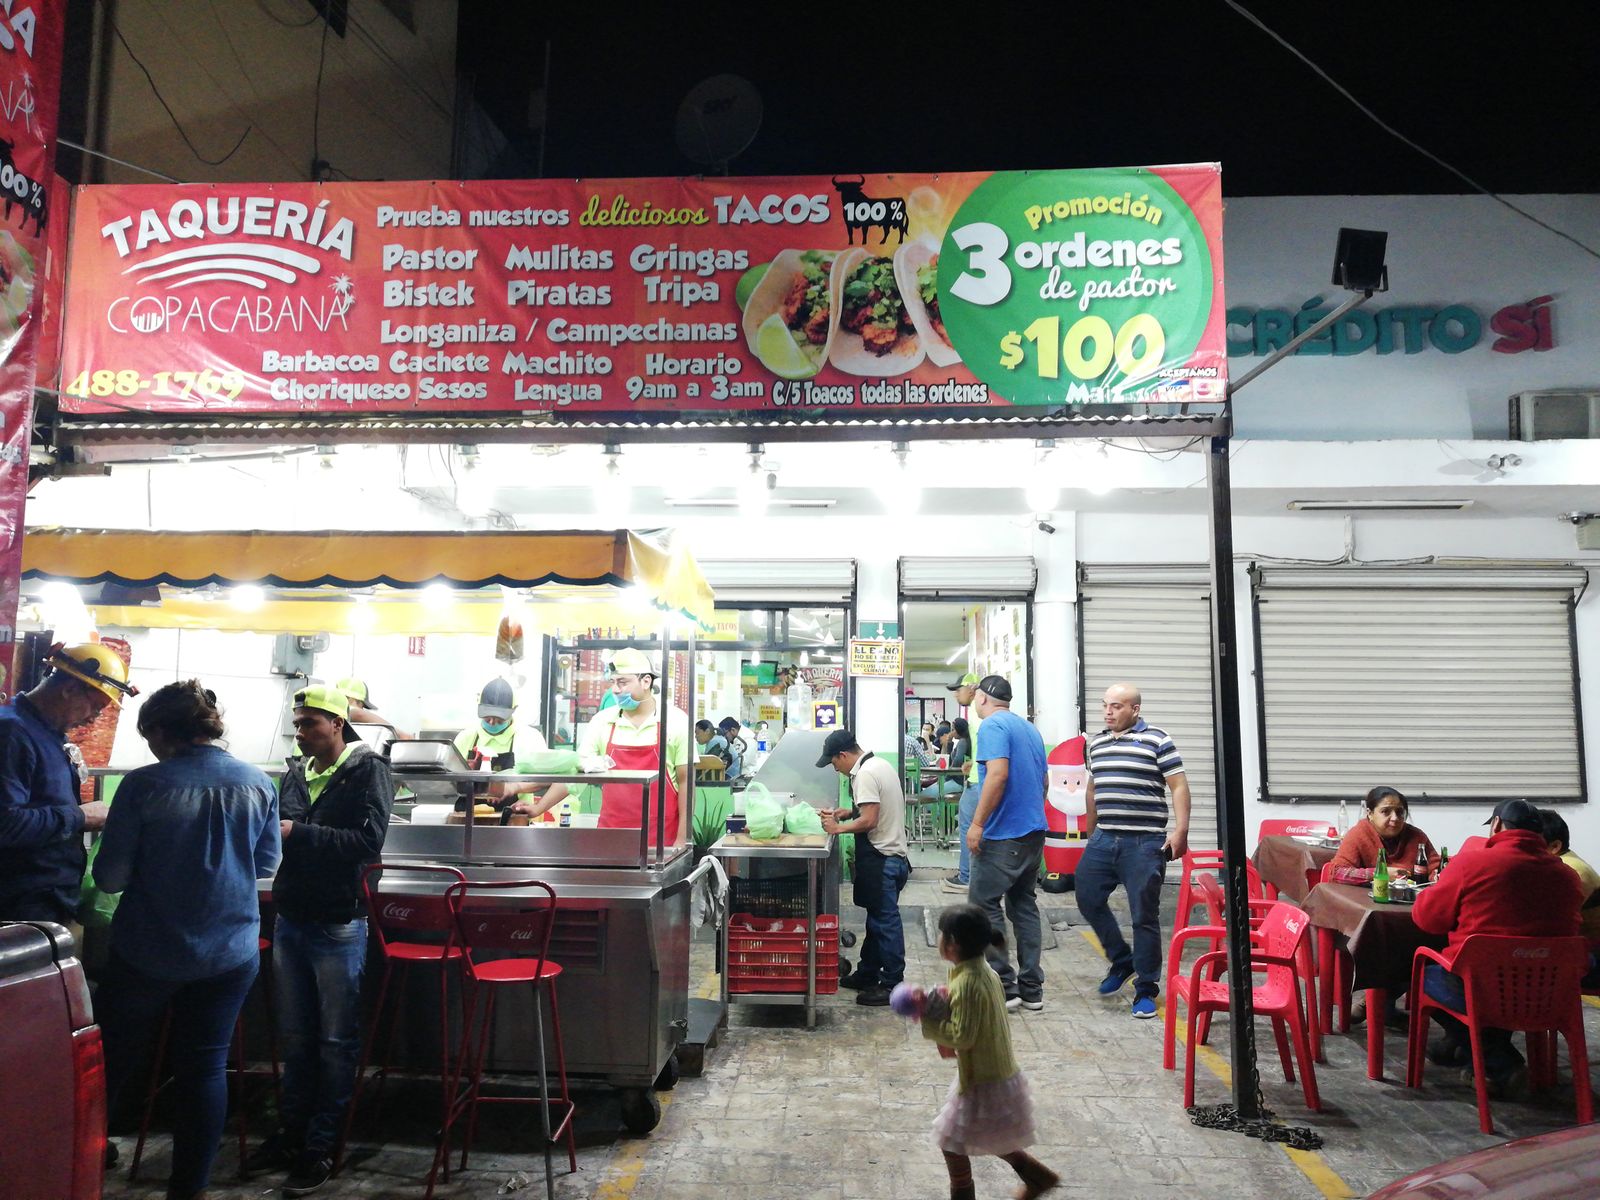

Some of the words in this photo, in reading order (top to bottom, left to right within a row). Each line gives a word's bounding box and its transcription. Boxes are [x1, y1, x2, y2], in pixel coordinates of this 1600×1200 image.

[377, 205, 460, 227] Prueba
[469, 207, 569, 227] nuestros
[579, 195, 709, 227] deliciosos
[714, 195, 829, 224] TACOS
[1024, 192, 1163, 231] Promoción
[101, 197, 354, 260] TAQUERÍA
[382, 244, 478, 271] Pastor
[504, 243, 614, 271] Mulitas
[630, 244, 749, 276] Gringas
[950, 222, 1012, 305] 3
[1014, 231, 1183, 269] ordenes
[383, 280, 476, 307] Bistek
[507, 280, 612, 306] Piratas
[643, 275, 720, 307] Tripa
[1039, 267, 1075, 299] de
[1079, 270, 1177, 312] pastor
[107, 295, 348, 332] COPACABANA
[1226, 295, 1482, 356] CRÉDITO
[1490, 295, 1555, 354] SÍ
[381, 319, 516, 348] Longaniza
[546, 317, 738, 346] Campechanas
[999, 313, 1166, 381] $100
[262, 350, 380, 372] Barbacoa
[389, 350, 490, 373] Cachete
[502, 351, 613, 375] Machito
[645, 353, 742, 376] Horario
[66, 369, 245, 401] 488-1769
[270, 377, 411, 404] Choriqueso
[418, 377, 488, 400] Sesos
[514, 379, 603, 406] Lengua
[625, 376, 677, 400] 9am
[686, 385, 700, 397] a
[711, 376, 764, 400] 3am
[772, 380, 801, 406] C/5
[804, 382, 854, 405] Toacos
[861, 378, 901, 405] todas
[905, 379, 927, 404] las
[928, 379, 988, 404] ordenes
